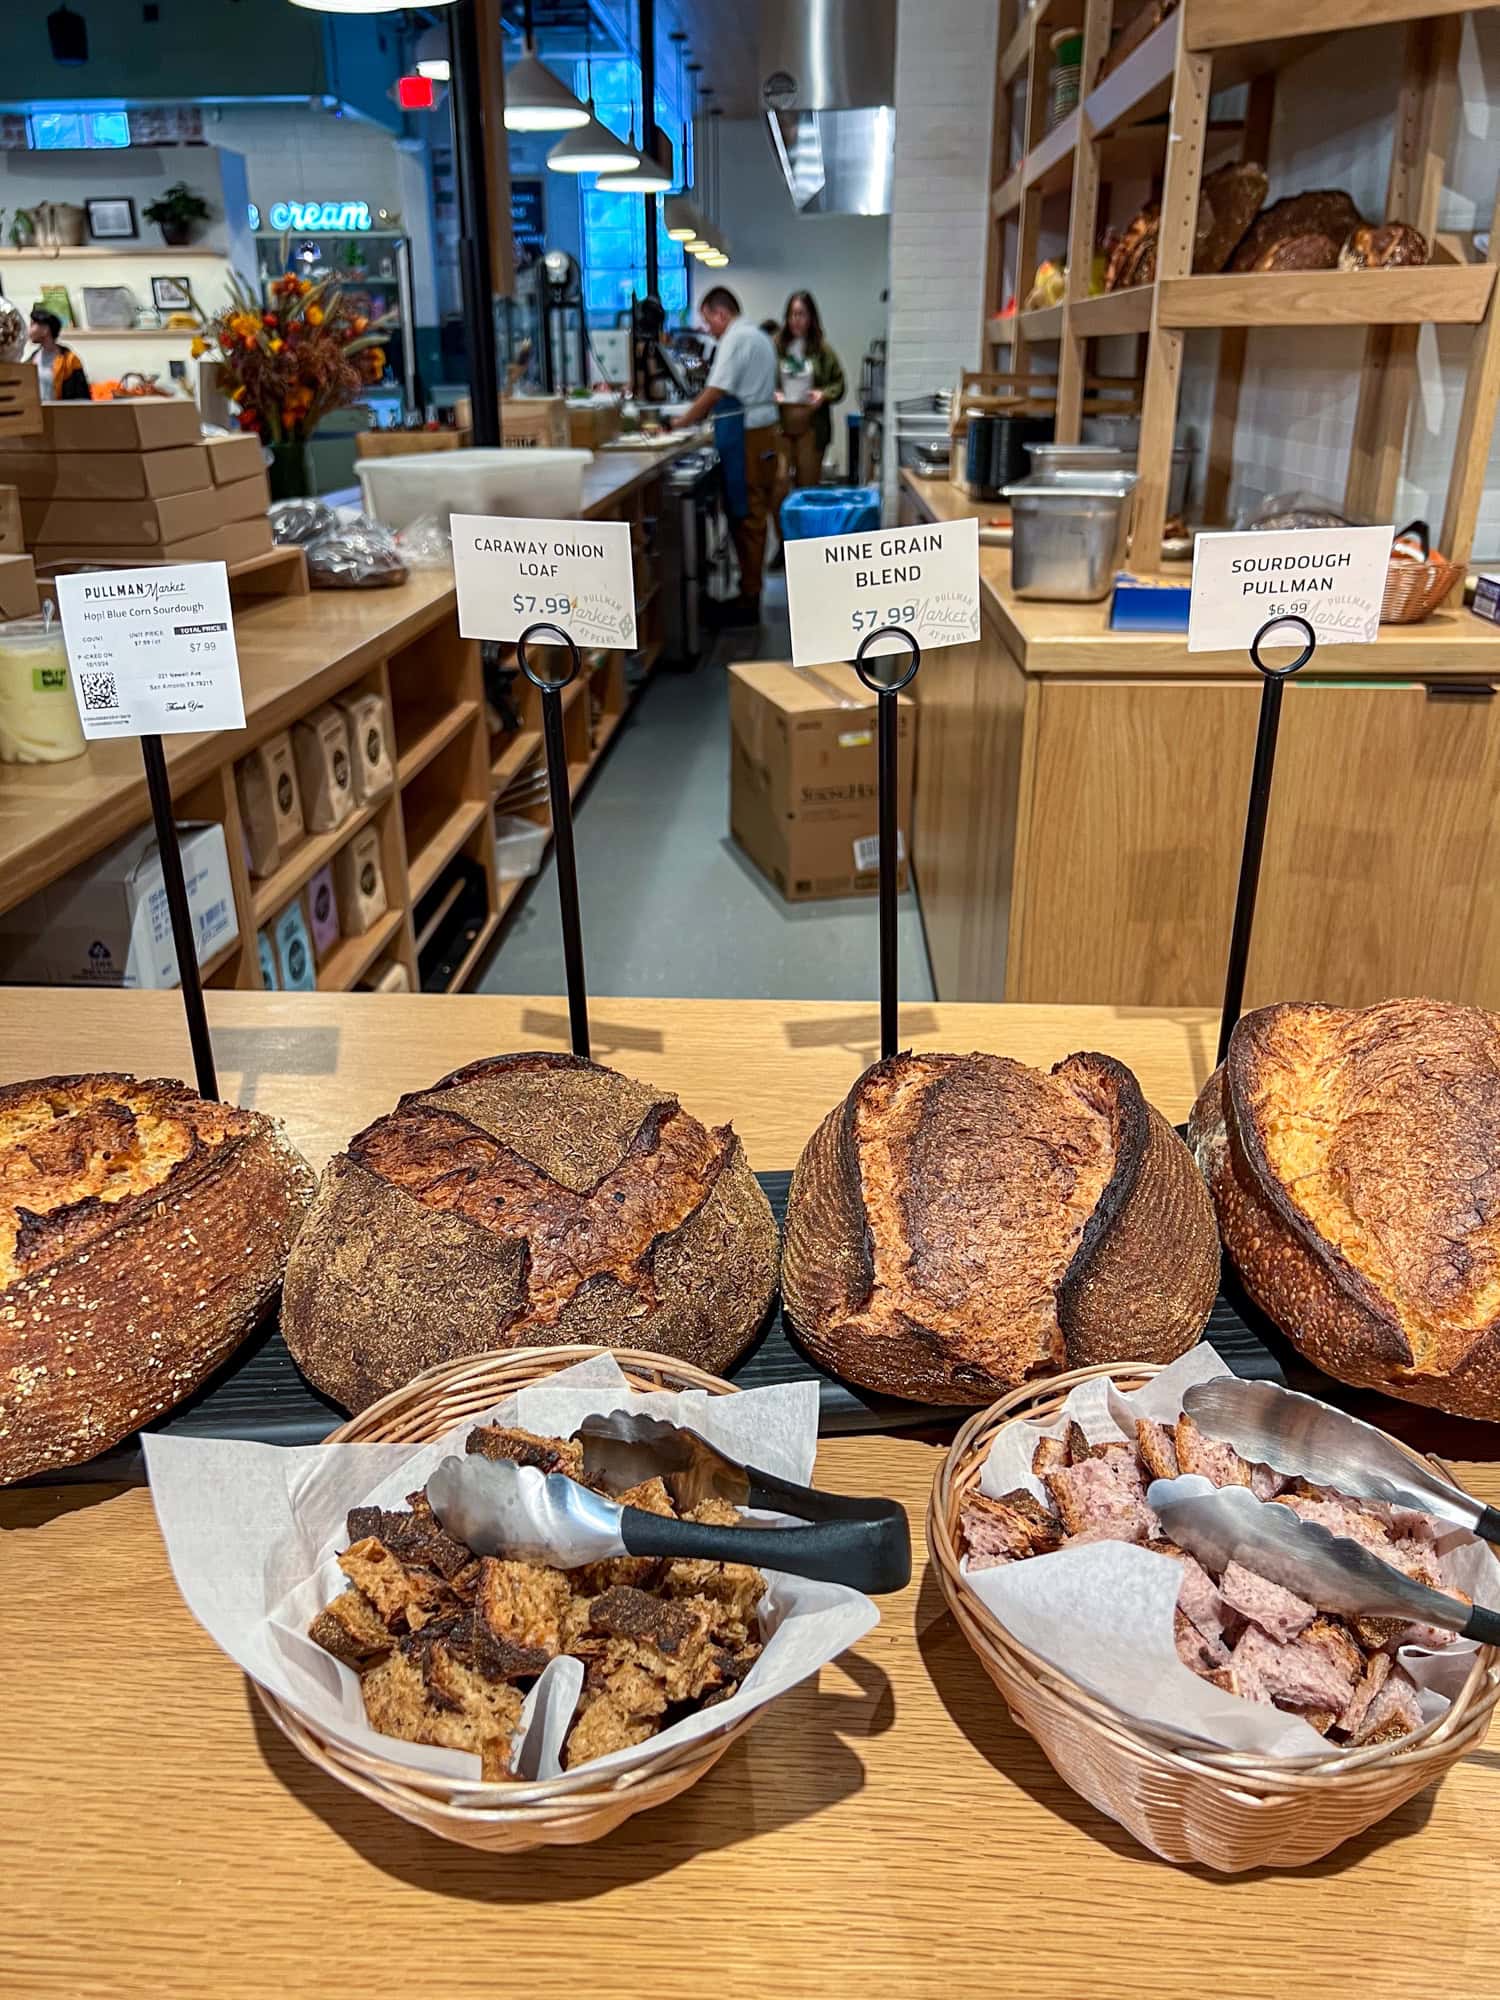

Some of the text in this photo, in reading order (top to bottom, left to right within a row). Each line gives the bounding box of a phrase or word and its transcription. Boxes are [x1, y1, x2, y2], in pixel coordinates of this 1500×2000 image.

[269, 200, 371, 231] cream
[474, 537, 604, 559] CARAWAY ONION
[824, 534, 943, 564] NINE GRAIN
[519, 562, 558, 577] LOAF
[1231, 552, 1352, 574] SOURDOUGH
[855, 565, 922, 588] BLEND
[1242, 577, 1334, 596] PULLMAN
[85, 581, 186, 602] PULLMAN Market
[107, 609, 127, 619] Blue
[129, 607, 151, 617] Corn
[153, 602, 205, 616] Sourdough
[512, 593, 571, 615] $7.99
[1267, 602, 1308, 617] $6.99
[851, 604, 916, 632] $7.99
[180, 624, 221, 635] TOTAL PRICE
